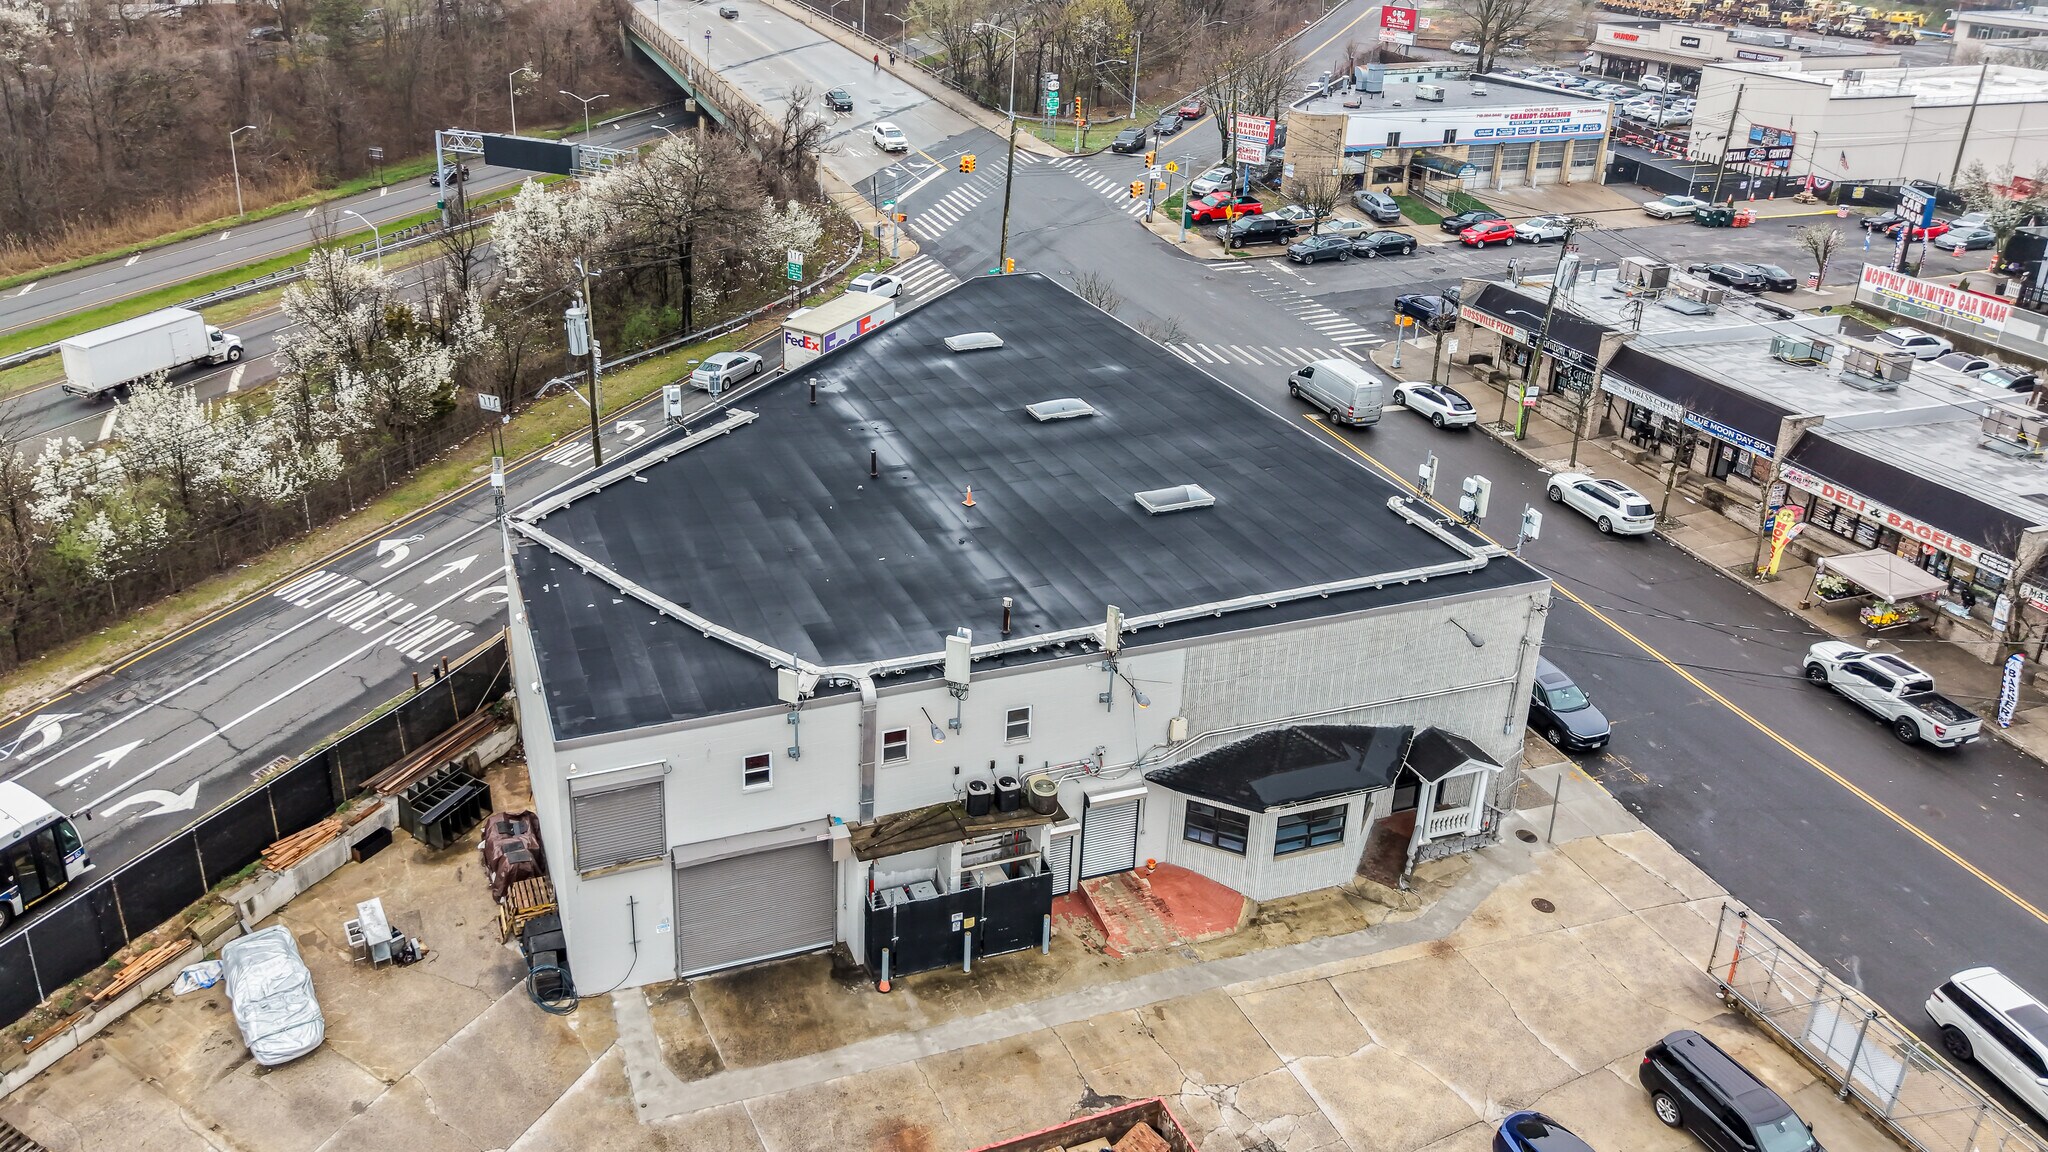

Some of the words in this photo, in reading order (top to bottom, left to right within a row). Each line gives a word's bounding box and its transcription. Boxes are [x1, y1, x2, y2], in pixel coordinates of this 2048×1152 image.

[1237, 121, 1267, 131] HARIOT
[1539, 111, 1571, 119] COLLISION
[1768, 148, 1792, 159] CENTER
[1896, 204, 1924, 226] WASH
[1901, 196, 1922, 213] CAR
[1864, 267, 1905, 292] MONTHLY
[1906, 280, 1956, 308] UNLIMITED
[1957, 294, 1977, 313] CAR
[1979, 300, 2008, 323] WASH
[1881, 288, 1909, 302] JOIN
[1913, 298, 1942, 312] THE
[1943, 307, 1985, 324] CLUB
[1463, 307, 1496, 328] ROSSVILLE
[1496, 321, 1514, 336] PIZZA
[785, 331, 820, 352] FedEx
[1624, 385, 1653, 403] EXPRESS
[1688, 413, 1709, 428] BLUE
[1710, 422, 1735, 438] MOON
[1735, 433, 1754, 446] DAY
[1753, 441, 1772, 454] SPA
[1772, 521, 1787, 543] HOT
[1821, 484, 1866, 512] DELI
[1870, 507, 1881, 518] &
[1887, 512, 1973, 558] BAGELS
[273, 570, 362, 609] ONLY
[327, 590, 417, 634] ONLY
[385, 614, 475, 663] ONLY
